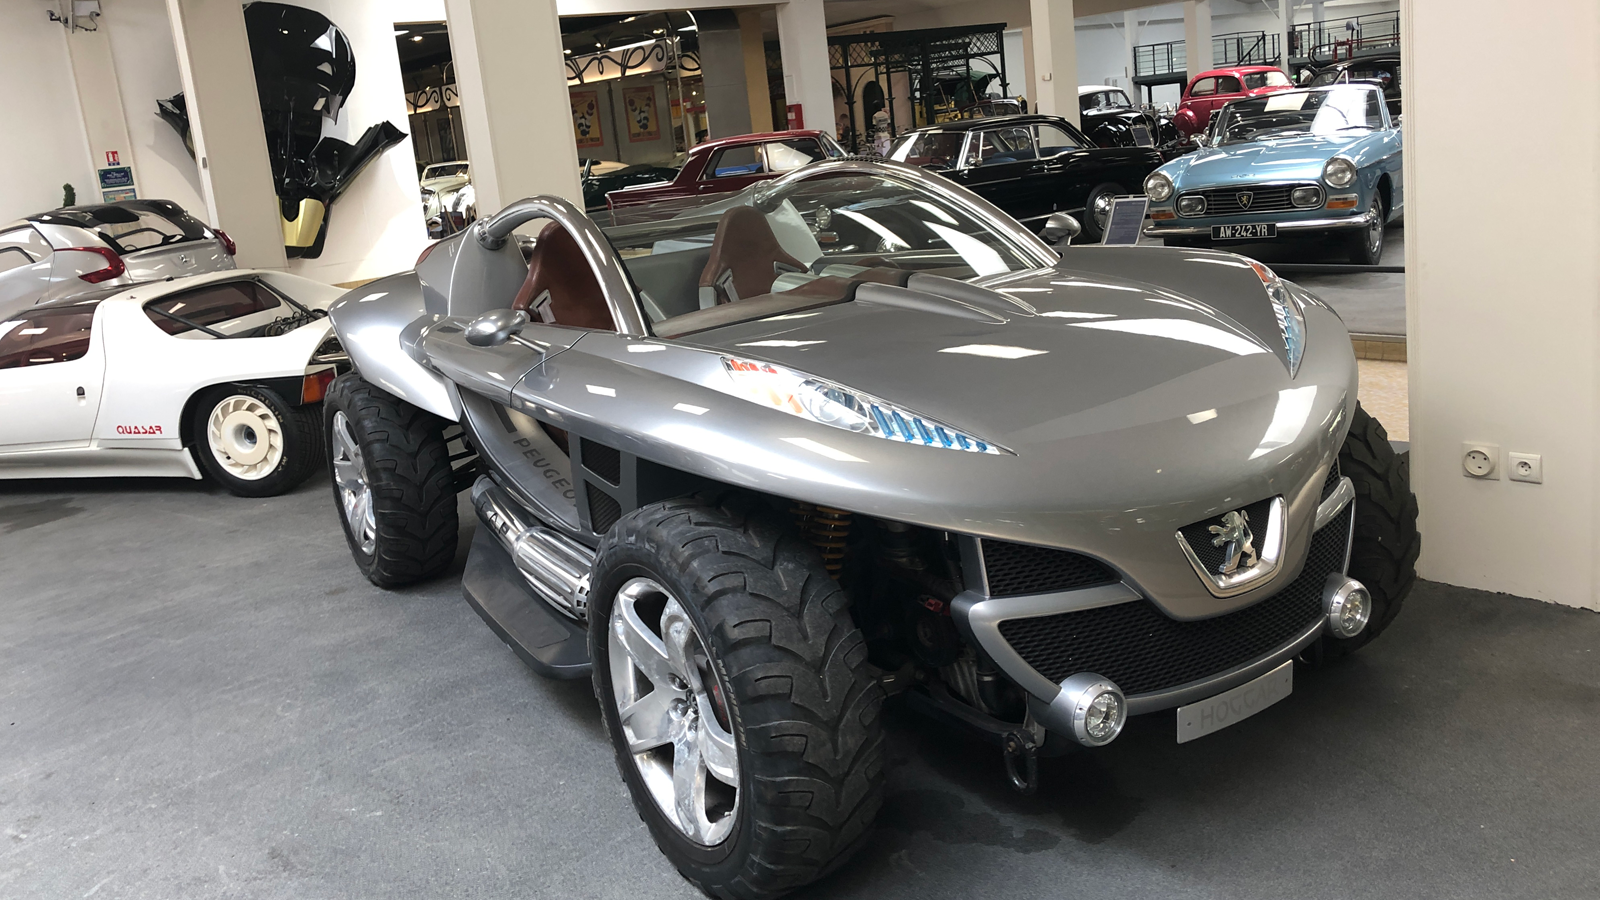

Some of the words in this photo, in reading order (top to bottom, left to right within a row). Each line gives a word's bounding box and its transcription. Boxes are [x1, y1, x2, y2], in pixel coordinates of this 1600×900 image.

[1219, 224, 1268, 239] AW-242-YR
[116, 424, 163, 435] QUASAR
[513, 437, 577, 507] PEUGEO
[716, 659, 749, 750] MICHELIN
[1200, 677, 1280, 729] HOGGAR
